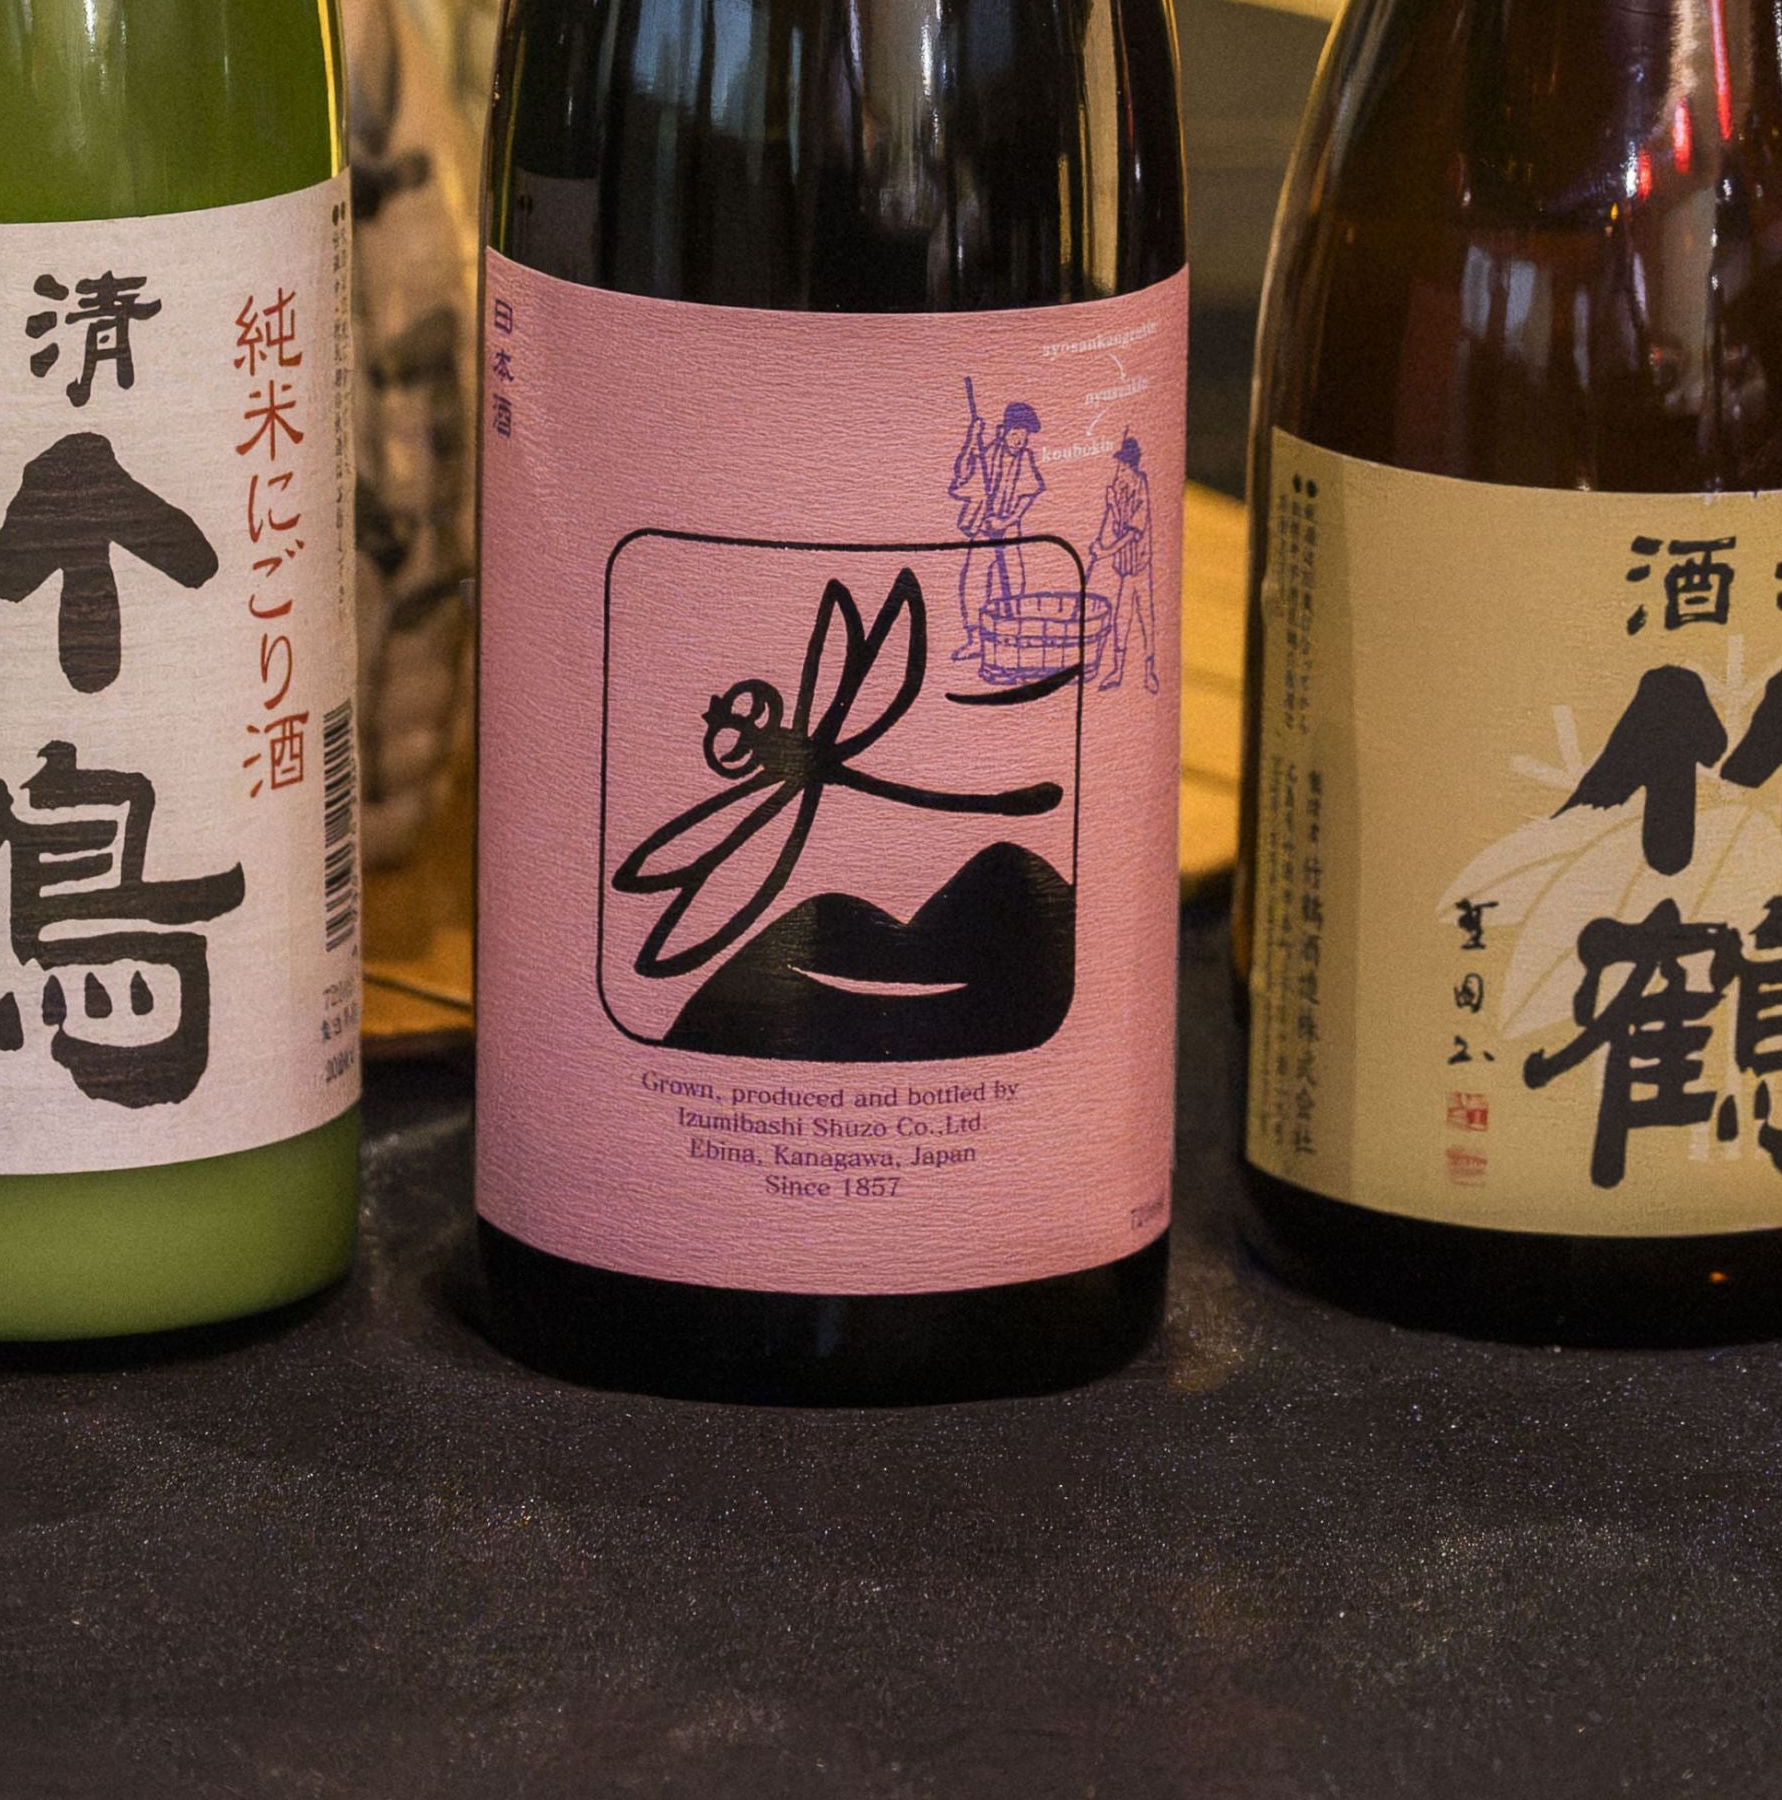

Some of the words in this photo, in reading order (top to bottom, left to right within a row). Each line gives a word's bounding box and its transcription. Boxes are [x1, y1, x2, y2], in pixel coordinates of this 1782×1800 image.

[492, 297, 515, 440] 日本酒
[233, 286, 310, 801] 純米にごり酒
[731, 1086, 845, 1108] produced
[854, 1087, 898, 1108] and
[907, 1082, 986, 1106] bottled
[993, 1079, 1020, 1102] by
[678, 1106, 803, 1137] Izumibashi
[812, 1117, 887, 1138] Shuzo
[689, 1137, 764, 1167] Ebina,
[773, 1143, 902, 1173] Kanagawa,
[910, 1146, 977, 1168] Japan
[765, 1173, 831, 1198] Since
[843, 1176, 902, 1198] 1857
